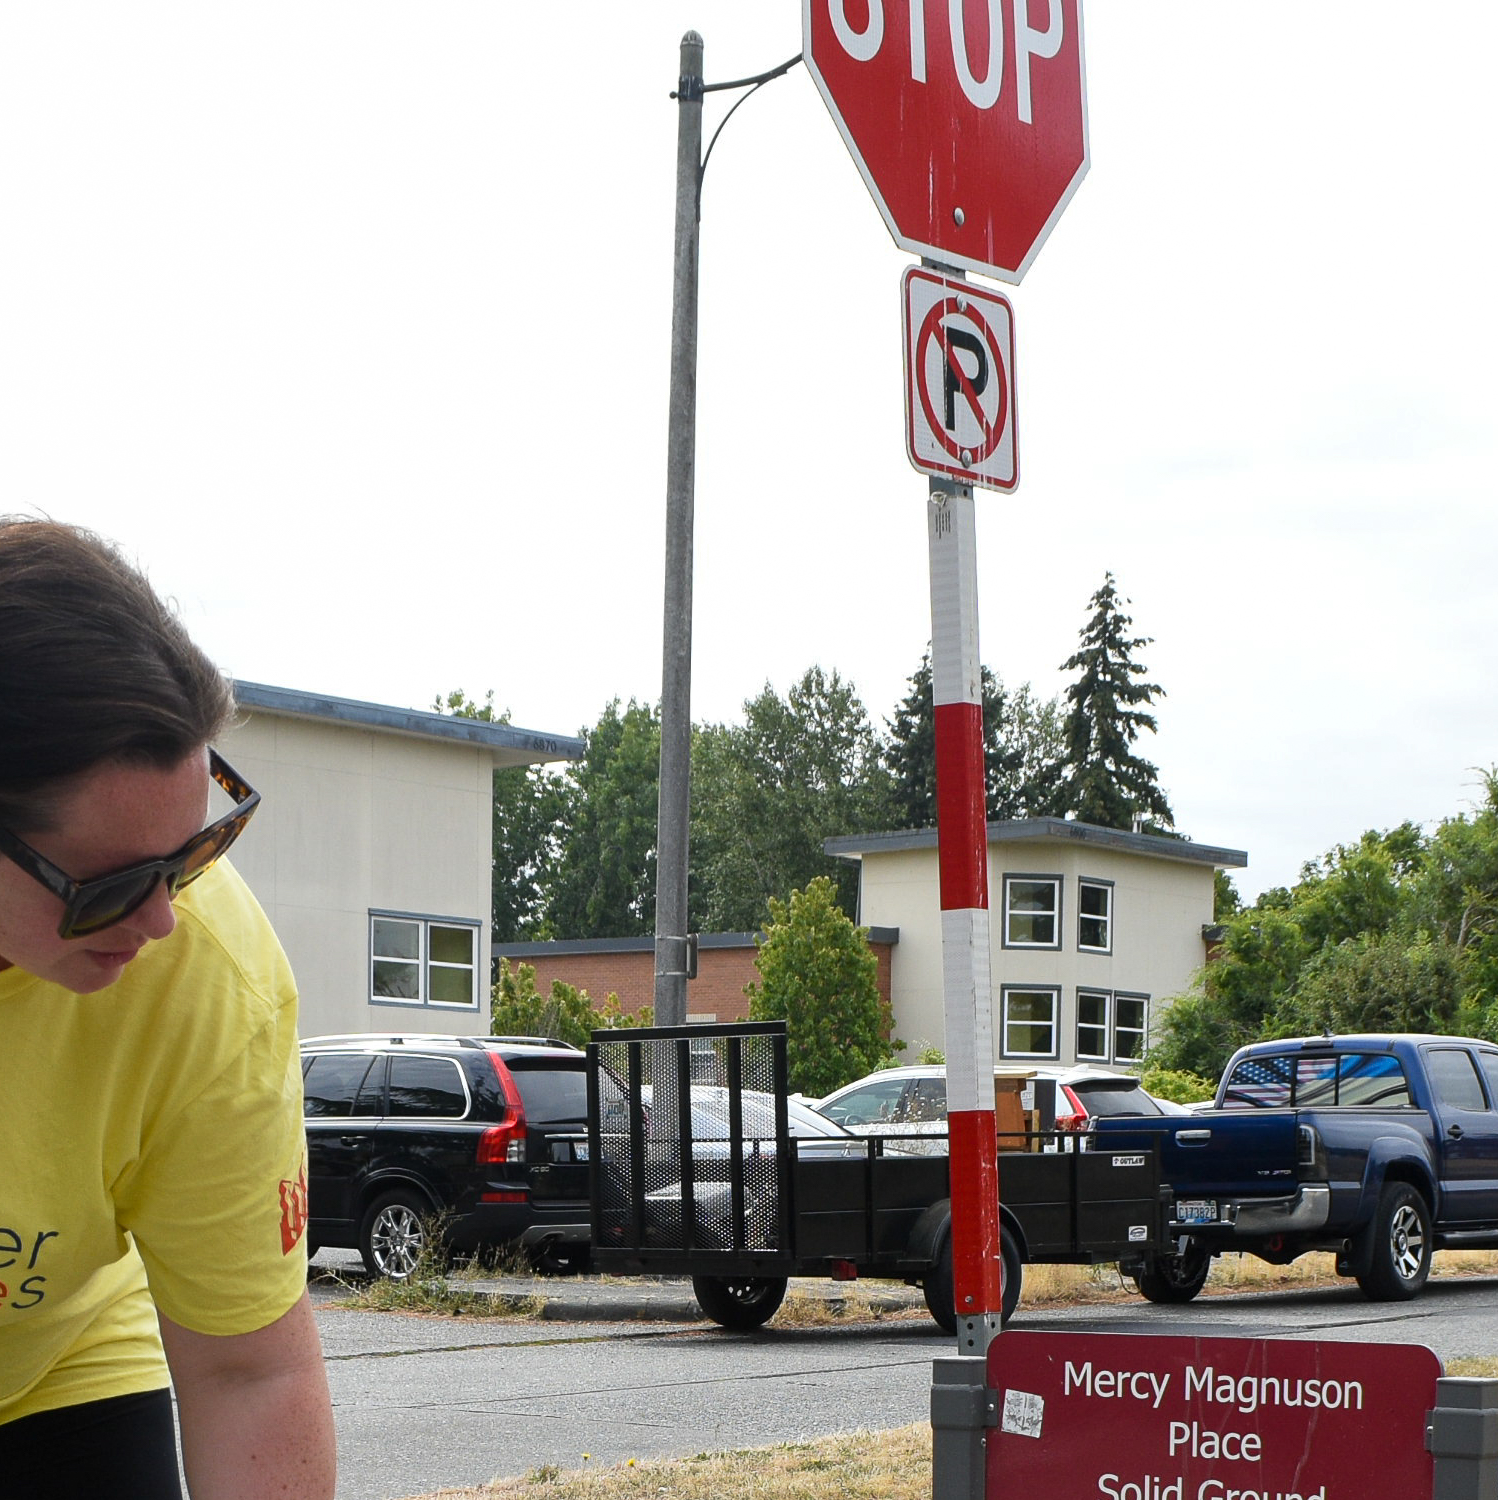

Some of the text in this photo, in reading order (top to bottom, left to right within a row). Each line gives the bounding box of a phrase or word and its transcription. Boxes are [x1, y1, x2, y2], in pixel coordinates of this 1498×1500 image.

[1064, 1361, 1364, 1413] Mercy Magnuson
[1169, 1421, 1262, 1461] Place
